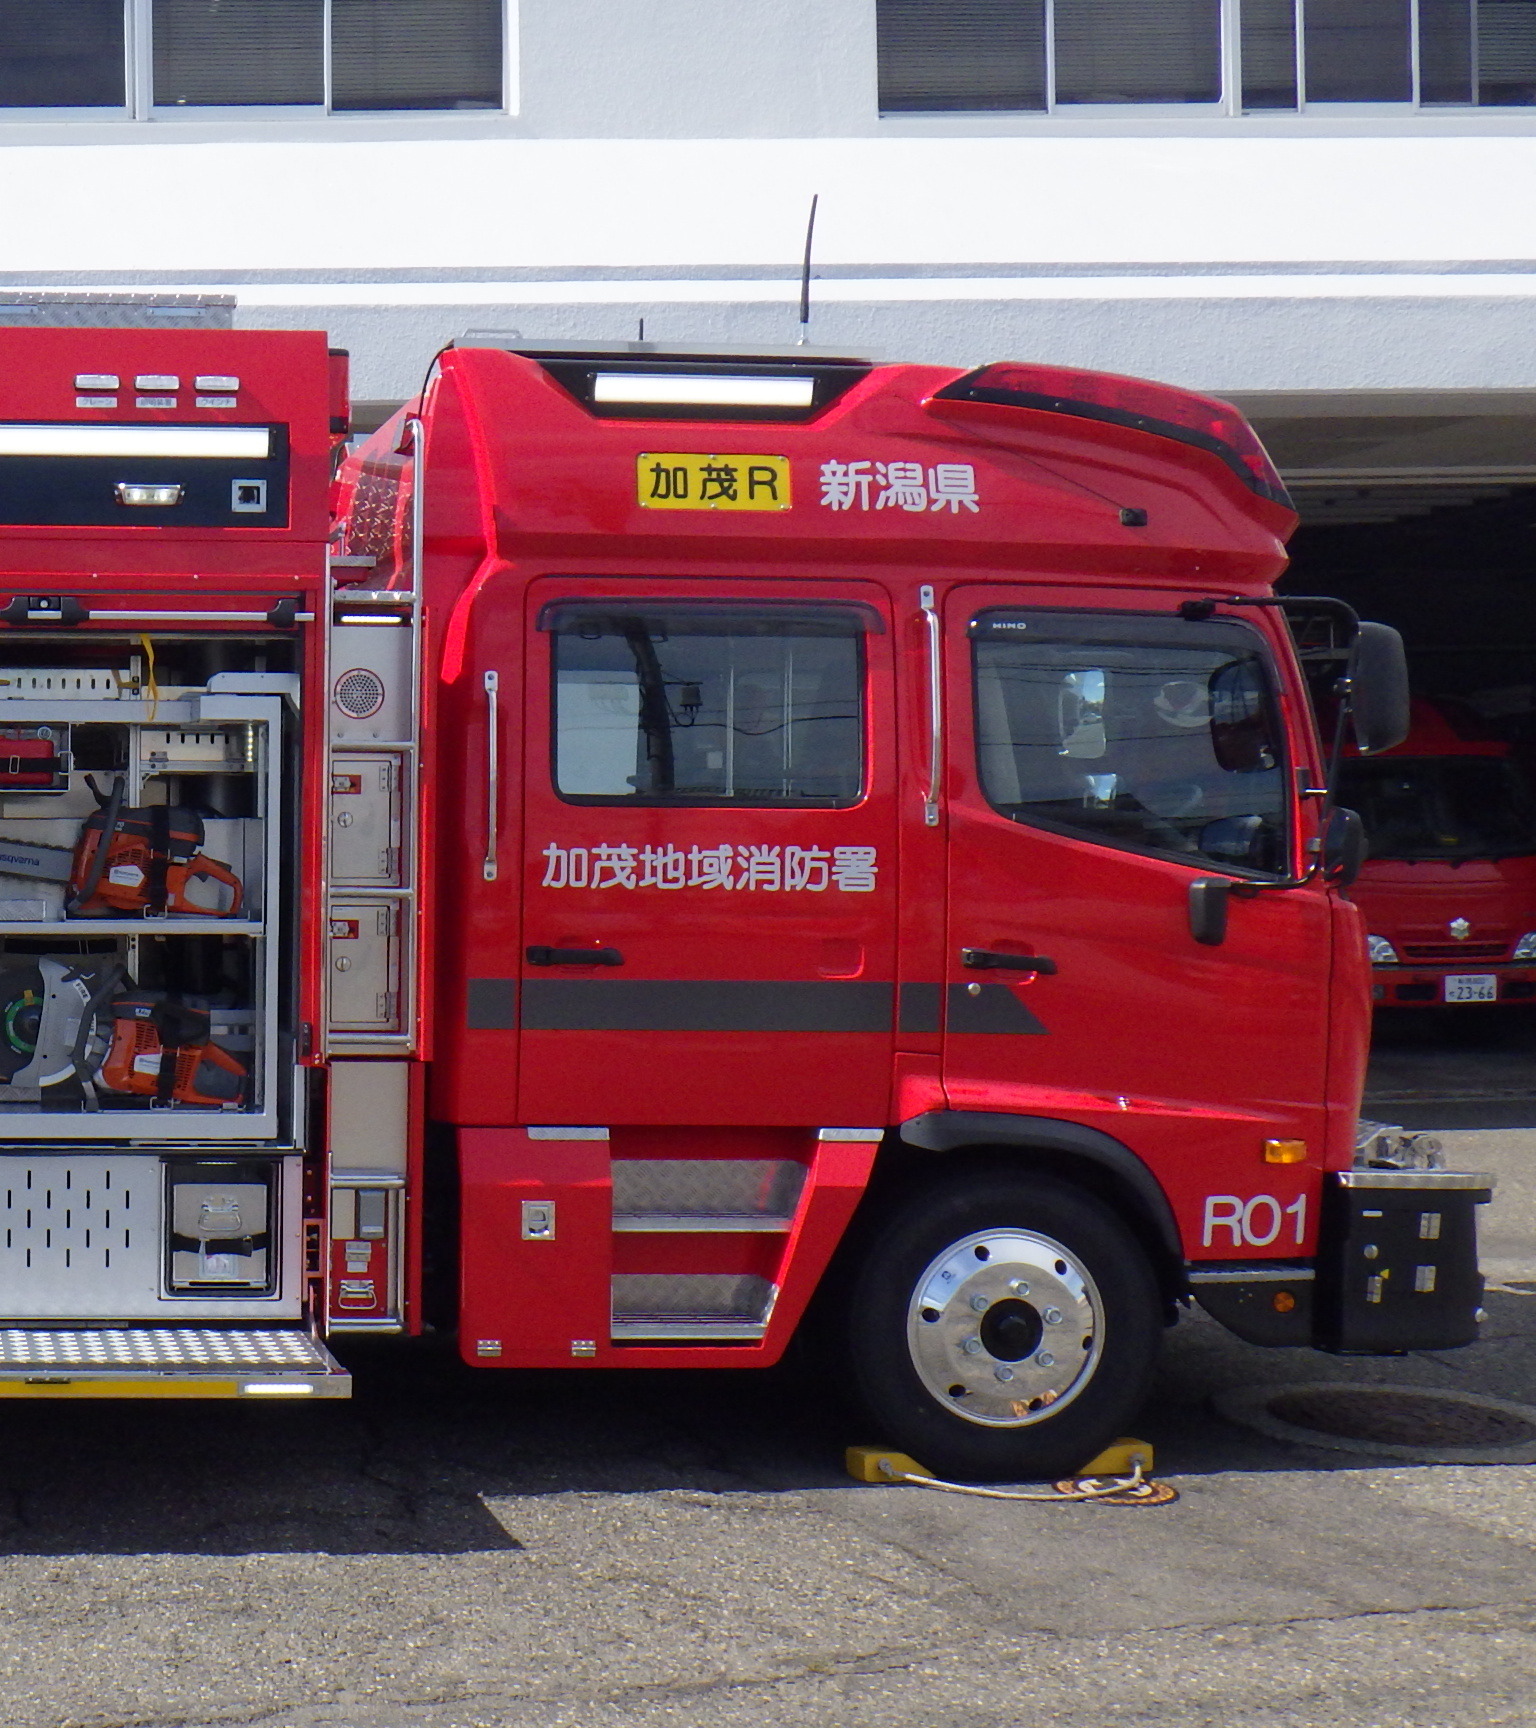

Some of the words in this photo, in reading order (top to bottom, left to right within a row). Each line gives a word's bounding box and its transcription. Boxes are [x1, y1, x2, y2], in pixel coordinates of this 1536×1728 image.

[648, 461, 780, 502] 加茂R
[819, 459, 980, 514] 新潟県
[992, 622, 1027, 630] HINO
[541, 842, 879, 893] 加茂地域消防署
